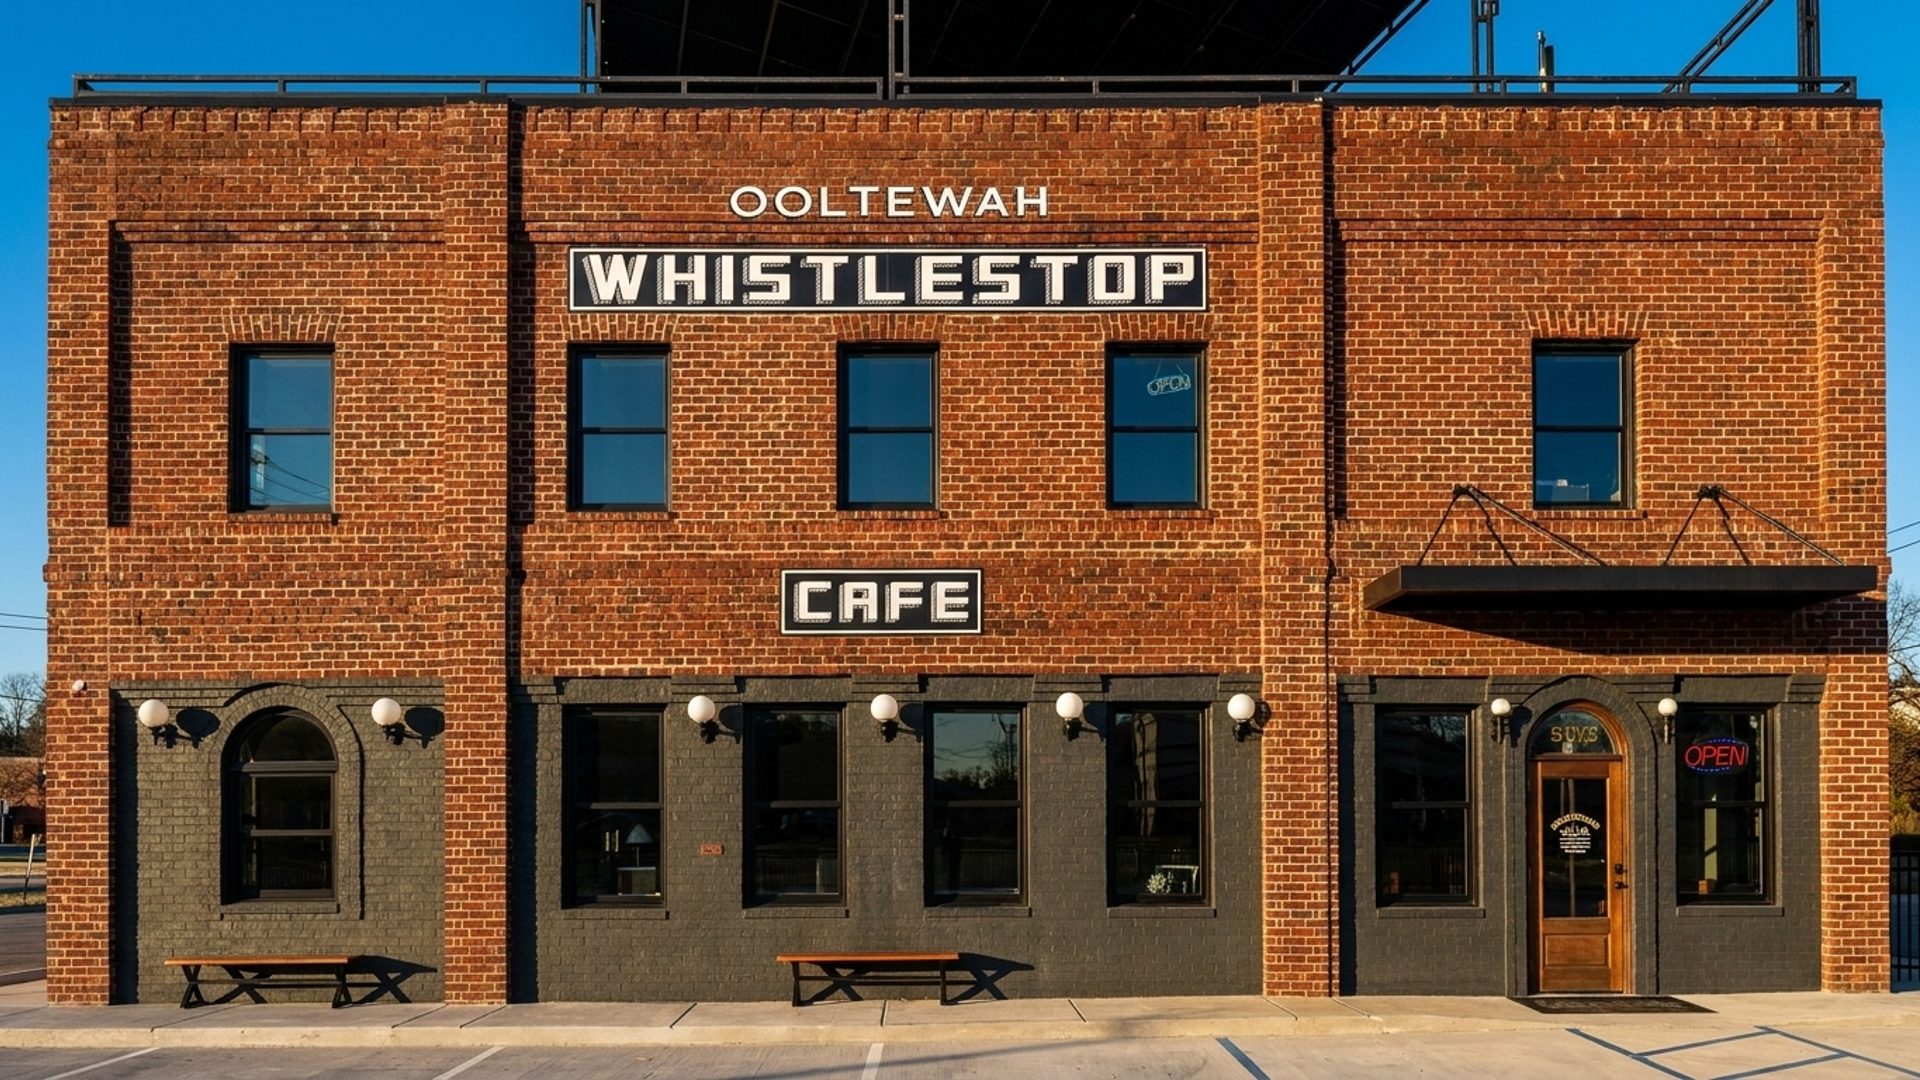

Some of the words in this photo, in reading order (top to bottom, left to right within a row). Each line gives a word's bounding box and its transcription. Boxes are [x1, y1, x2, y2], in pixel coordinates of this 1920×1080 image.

[730, 185, 1048, 218] OOLTEWAH
[582, 253, 1195, 305] WHISTLESTOP
[793, 581, 969, 623] CAFE
[1684, 745, 1745, 766] OPEN
